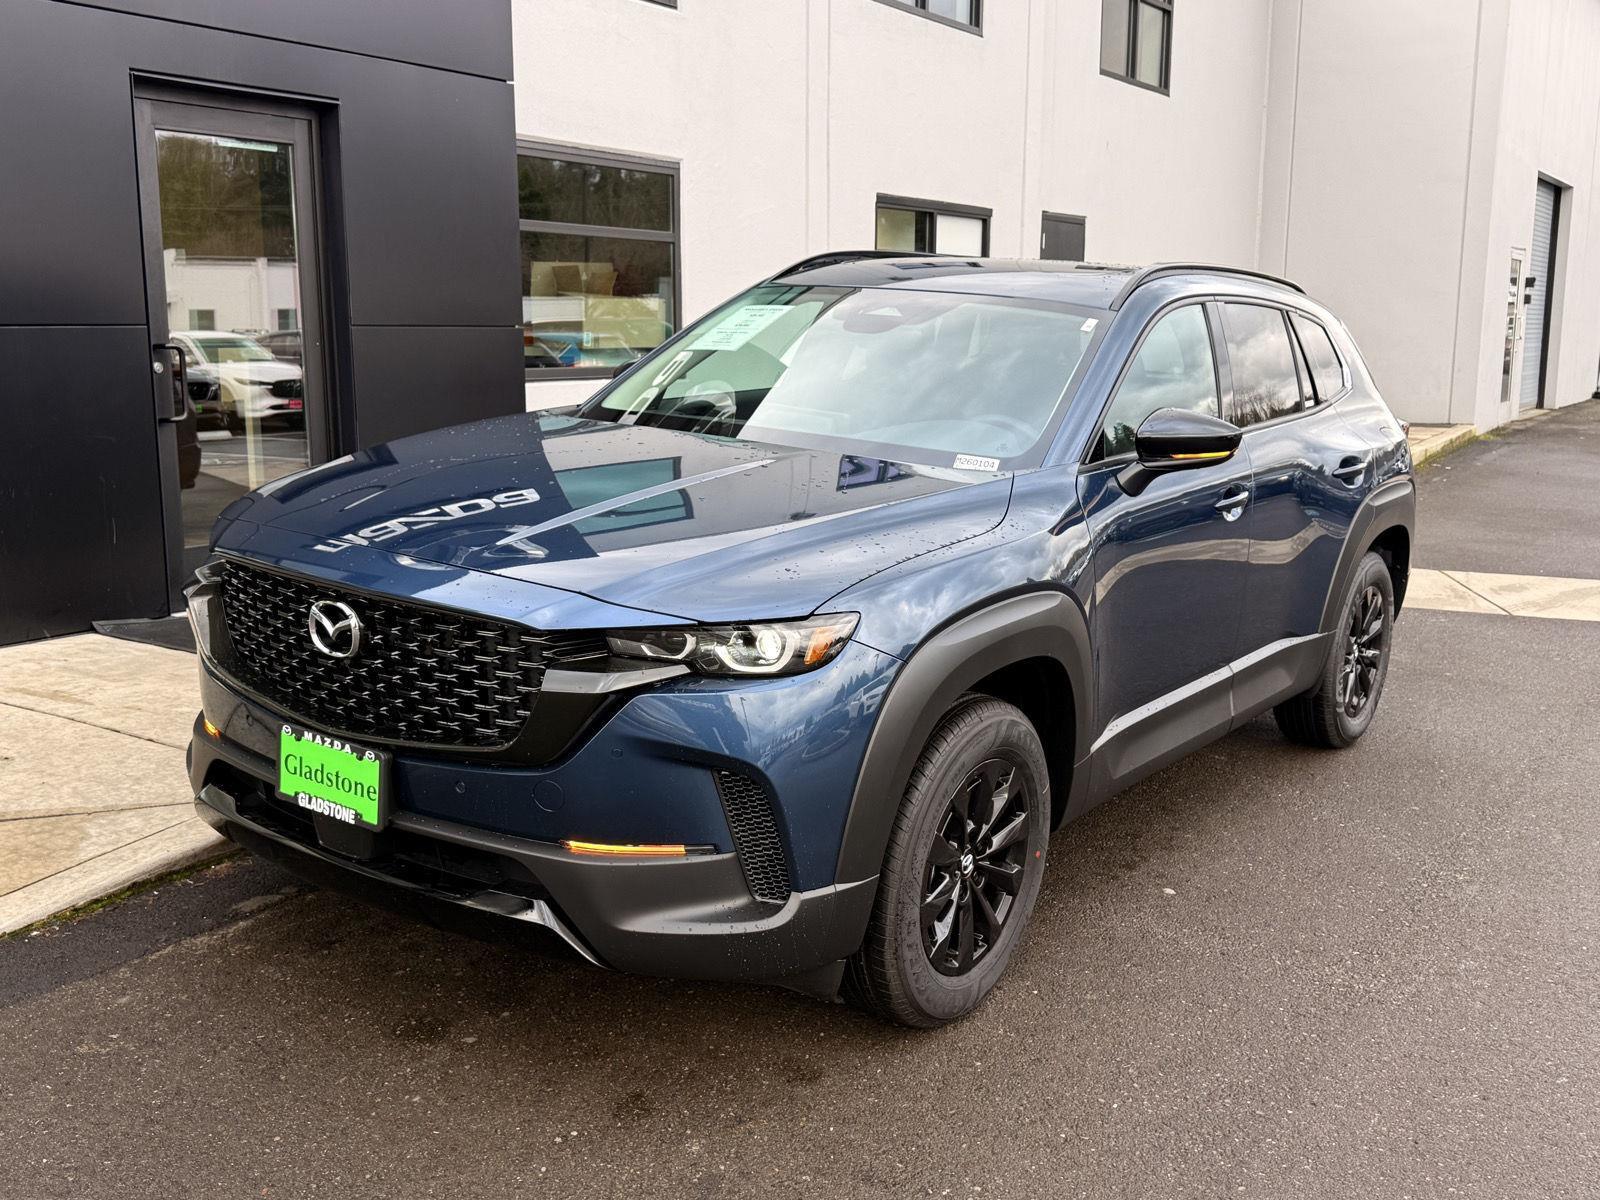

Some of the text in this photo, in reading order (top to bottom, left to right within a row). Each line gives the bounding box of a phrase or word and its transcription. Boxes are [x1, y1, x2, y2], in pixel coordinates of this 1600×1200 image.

[303, 731, 352, 755] MAZDA
[284, 753, 377, 802] Gladstone
[298, 792, 356, 825] GLADSTONE
